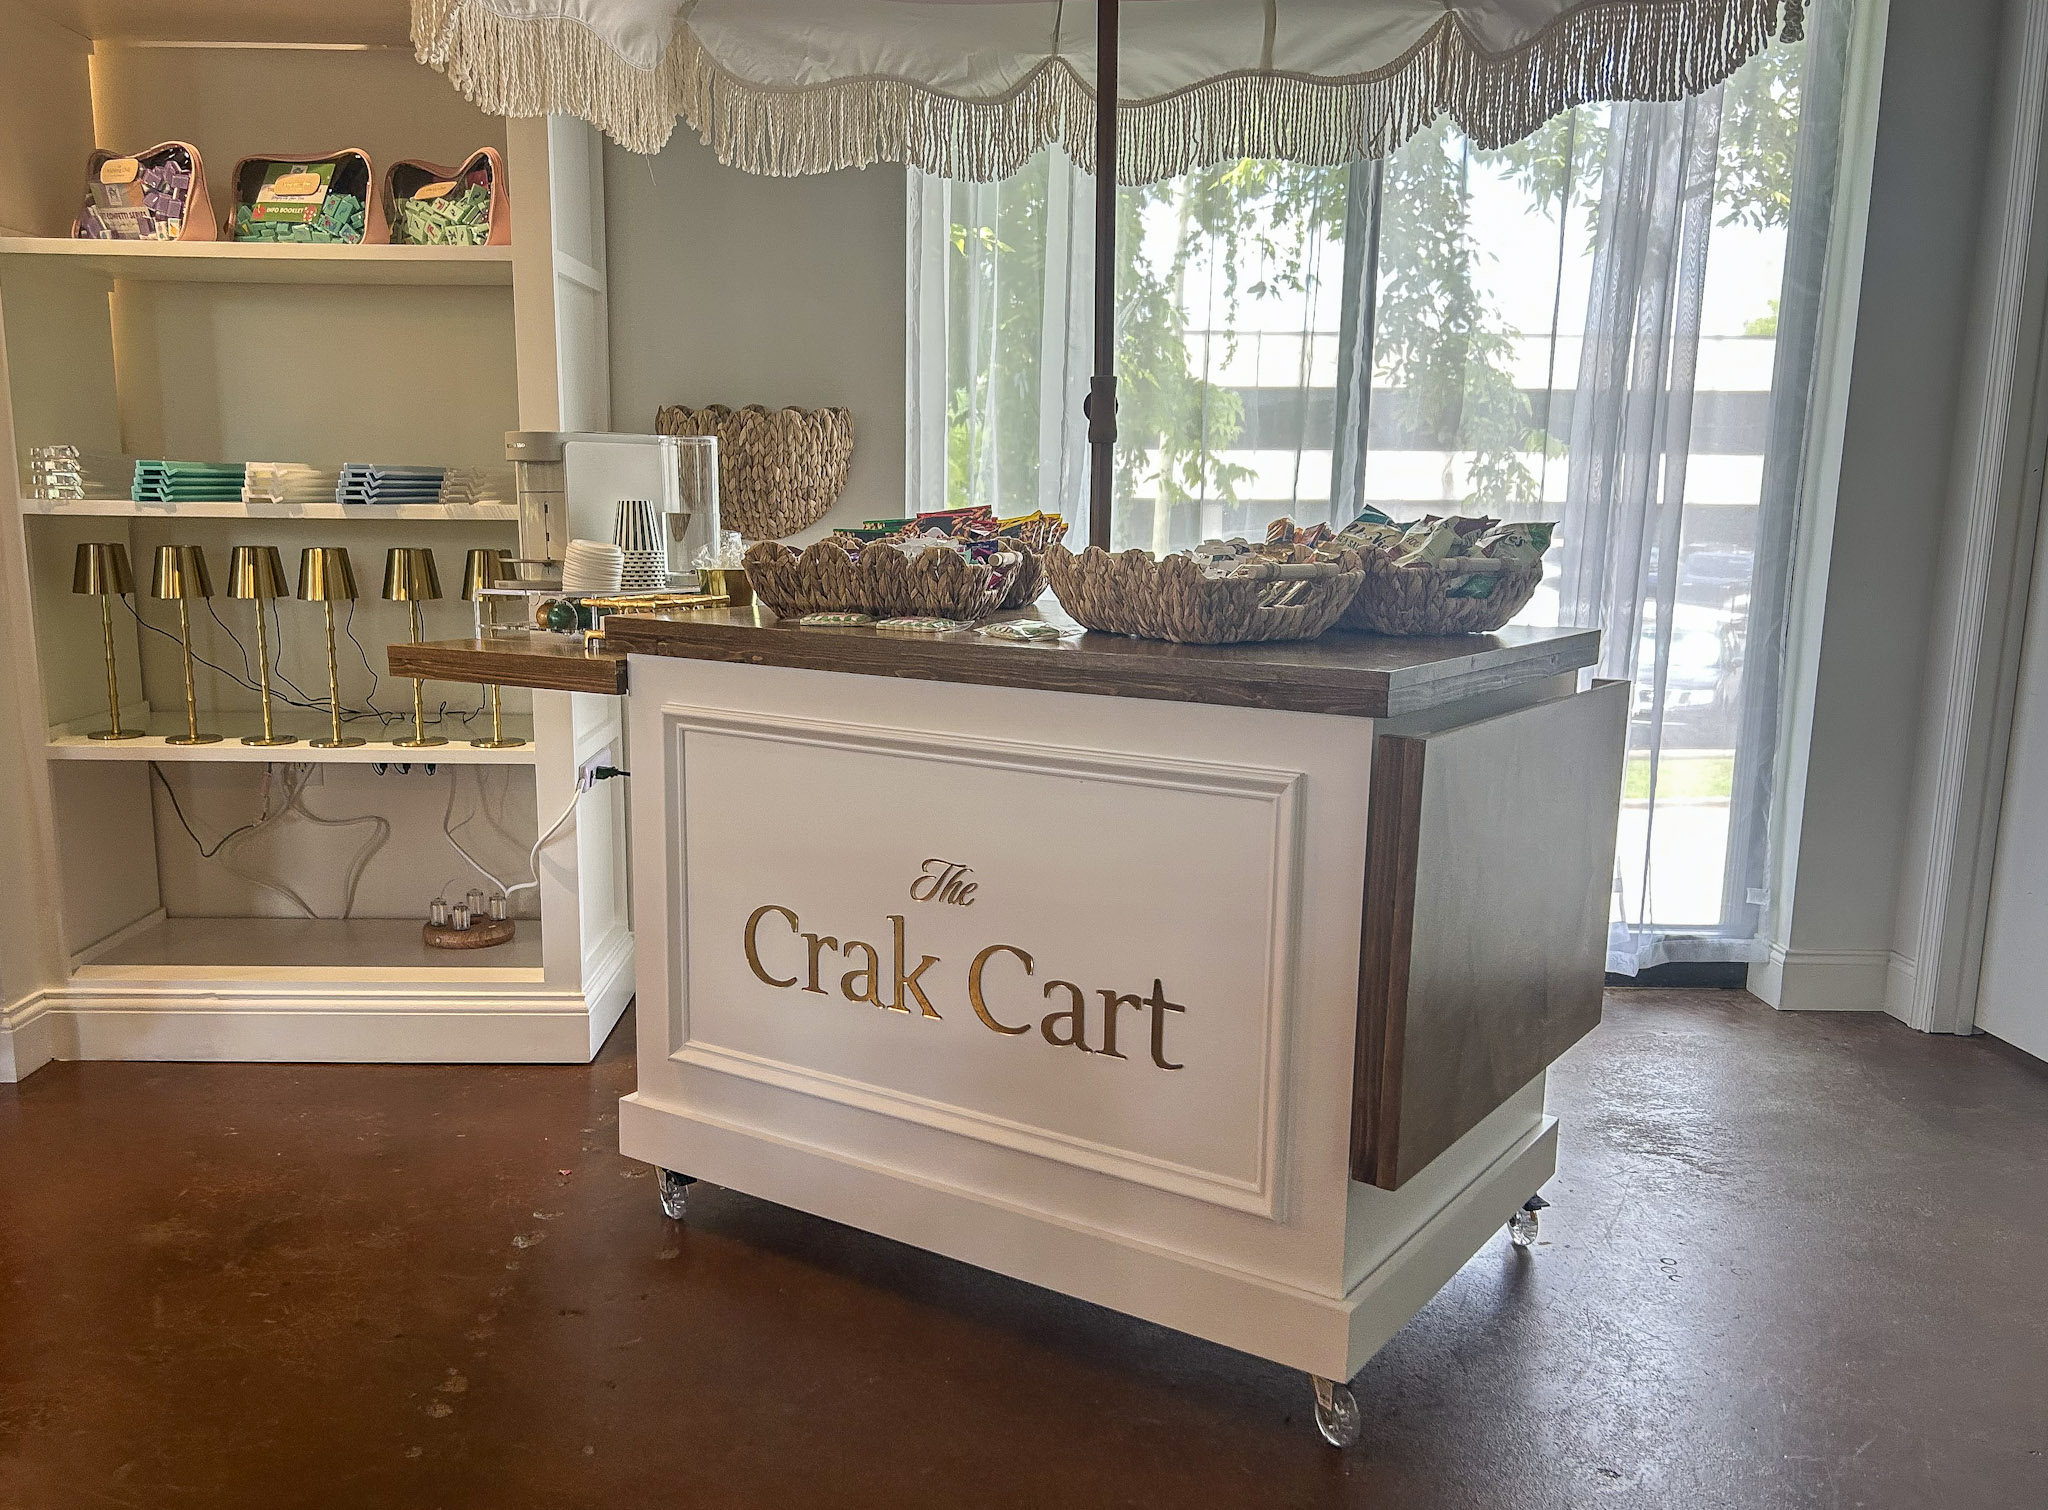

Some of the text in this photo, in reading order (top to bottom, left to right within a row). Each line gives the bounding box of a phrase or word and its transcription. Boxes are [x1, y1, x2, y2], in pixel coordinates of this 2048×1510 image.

[909, 857, 979, 907] The
[743, 904, 1186, 1071] Crak Cart
